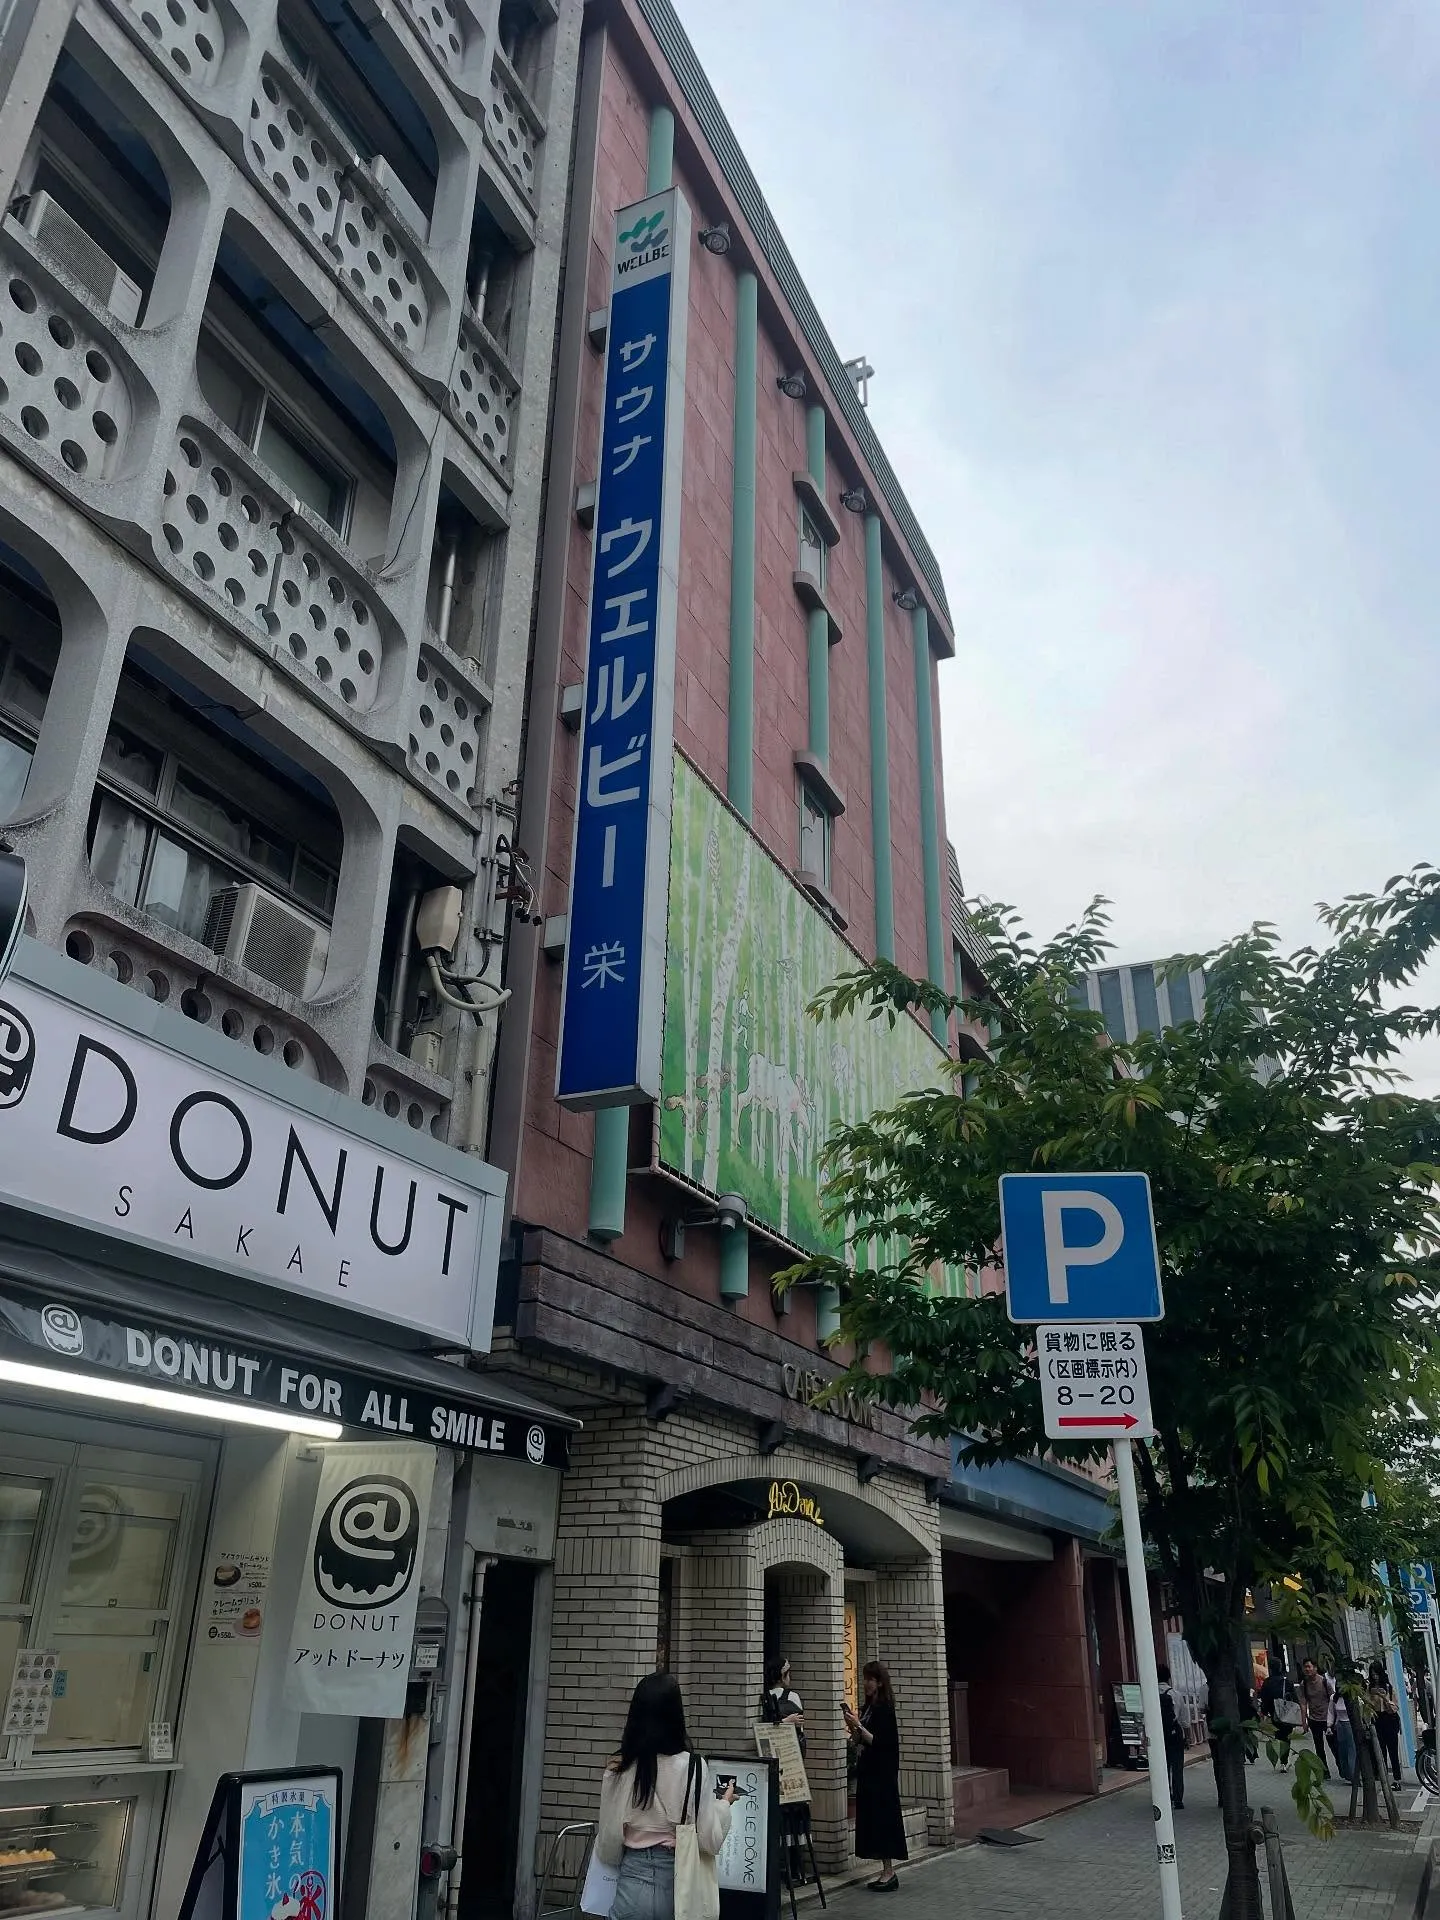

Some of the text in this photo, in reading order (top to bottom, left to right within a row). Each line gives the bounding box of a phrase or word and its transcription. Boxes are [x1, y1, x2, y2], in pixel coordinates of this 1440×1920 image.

[617, 243, 670, 275] WELLBE
[612, 333, 657, 475] サウナ
[581, 940, 626, 989] 栄
[56, 1033, 469, 1276] DONUT
[114, 1185, 351, 1288] SAKAE
[1041, 1191, 1124, 1304] P
[1044, 1331, 1136, 1353] 貨物に限る
[126, 1327, 260, 1396] DONUT
[279, 1367, 342, 1417] FOR
[360, 1390, 414, 1433] ALL
[430, 1406, 505, 1451] SMILE
[1057, 1384, 1135, 1406] 8-20
[313, 1613, 401, 1633] DONUT
[344, 1648, 405, 1670] ドーナツ
[266, 1816, 285, 1898] かき氷
[742, 1772, 760, 1885] CAFÉ LE DÔME
